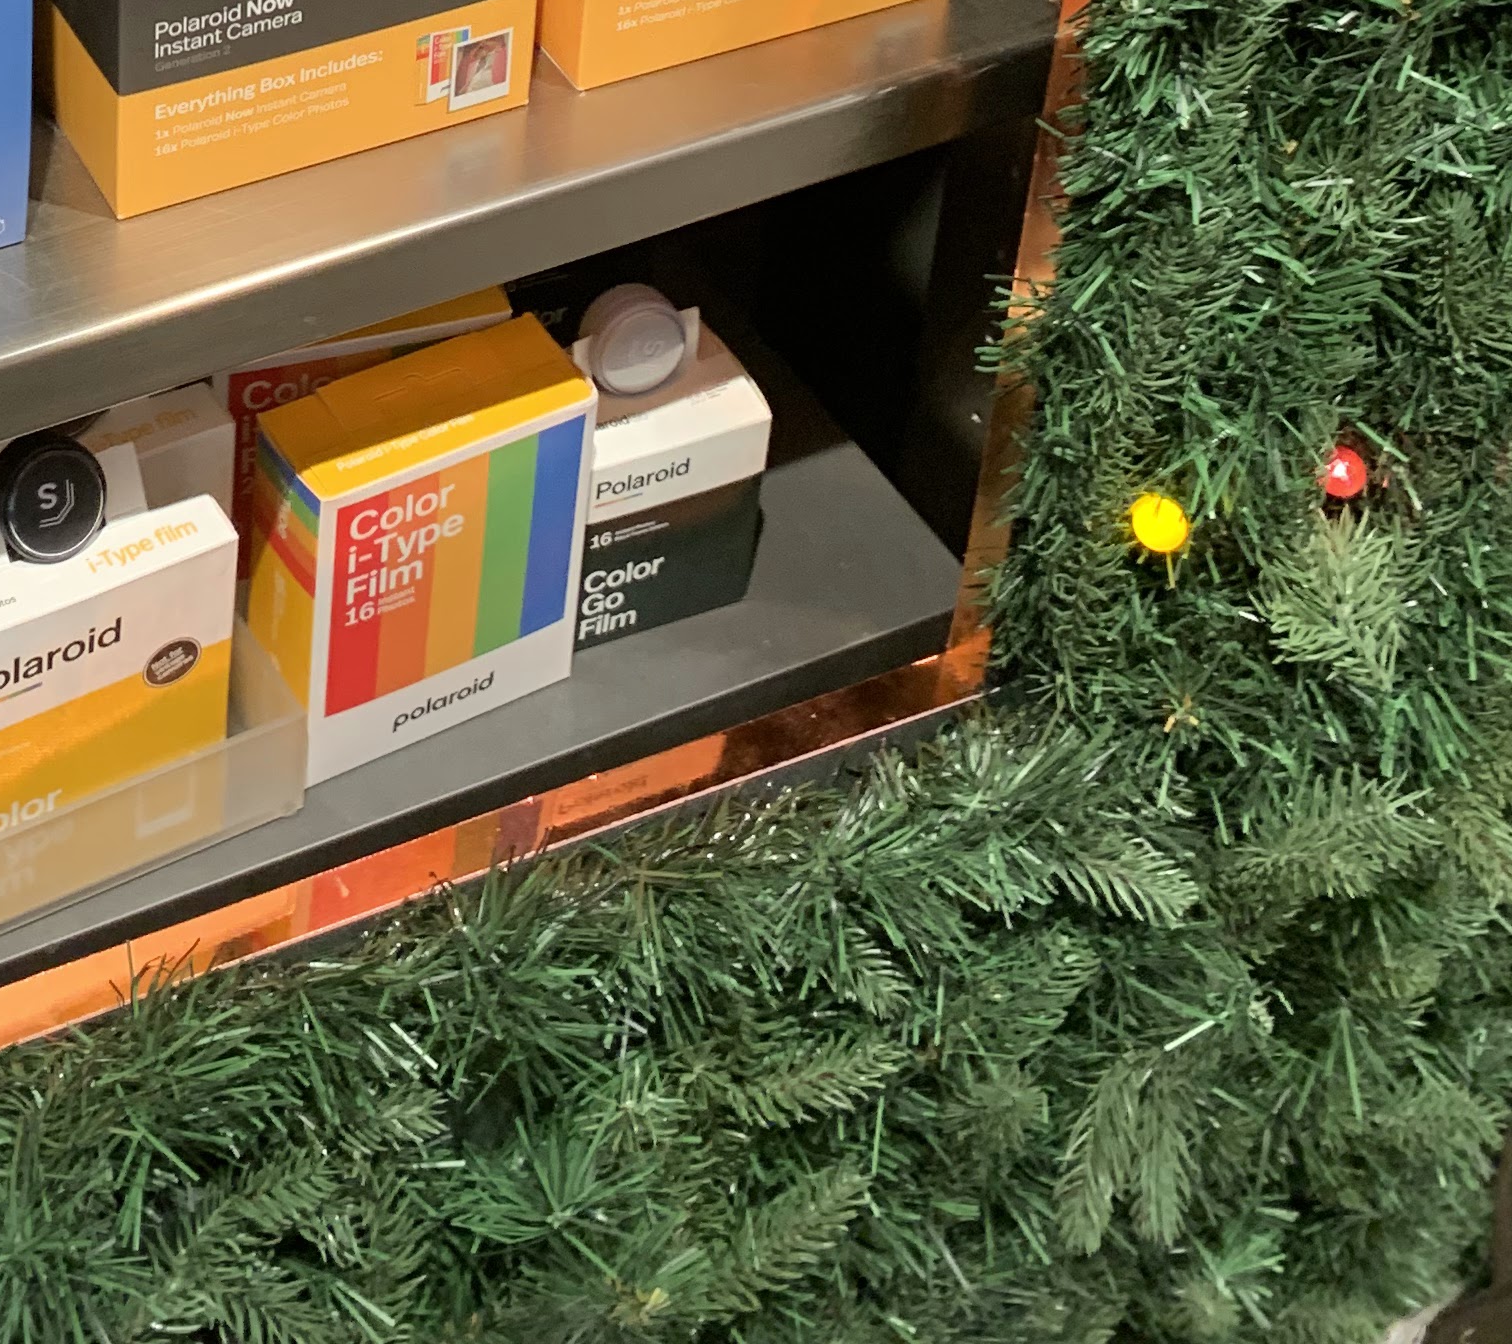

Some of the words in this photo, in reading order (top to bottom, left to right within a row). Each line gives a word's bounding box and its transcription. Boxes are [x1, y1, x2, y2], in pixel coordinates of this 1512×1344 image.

[154, 3, 242, 41] Polaroid
[154, 30, 222, 60] Instant
[226, 9, 303, 41] Camera
[154, 47, 222, 73] Generation
[154, 80, 256, 122] Everything
[259, 72, 297, 94] Box
[299, 49, 384, 84] Includes:
[172, 112, 224, 136] Polaroid
[224, 103, 255, 123] Now
[255, 91, 299, 113] Instant
[299, 81, 348, 105] Camera
[154, 142, 179, 158] 16x
[180, 129, 232, 151] Polaroid
[272, 107, 307, 126] Color
[307, 95, 351, 117] Photos
[596, 458, 691, 501] Polaroid
[349, 483, 456, 541] Color
[87, 534, 154, 574] i-Type
[154, 520, 199, 547] film
[348, 514, 465, 575] i-Type
[589, 531, 612, 550] 16
[346, 559, 423, 606] Film
[584, 556, 666, 593] Color
[344, 601, 375, 627] 16
[578, 608, 637, 641] Film
[581, 589, 625, 616] Go
[392, 671, 495, 734] polaroid
